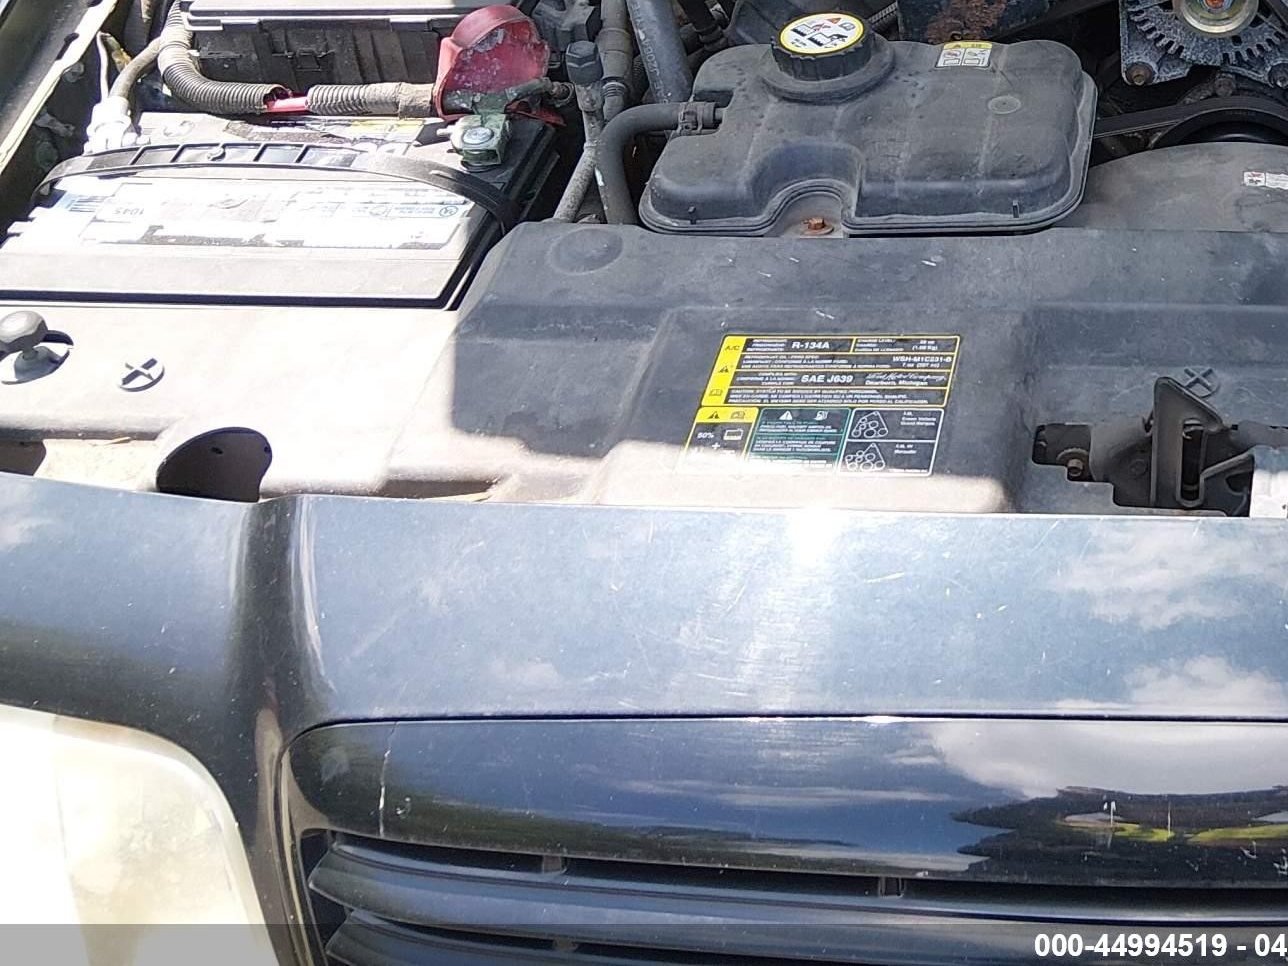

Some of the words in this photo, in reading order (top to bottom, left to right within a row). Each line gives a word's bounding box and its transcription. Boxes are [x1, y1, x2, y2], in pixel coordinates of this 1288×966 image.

[791, 341, 830, 350] R-134A
[800, 374, 827, 384] SAE
[828, 374, 854, 384] J639
